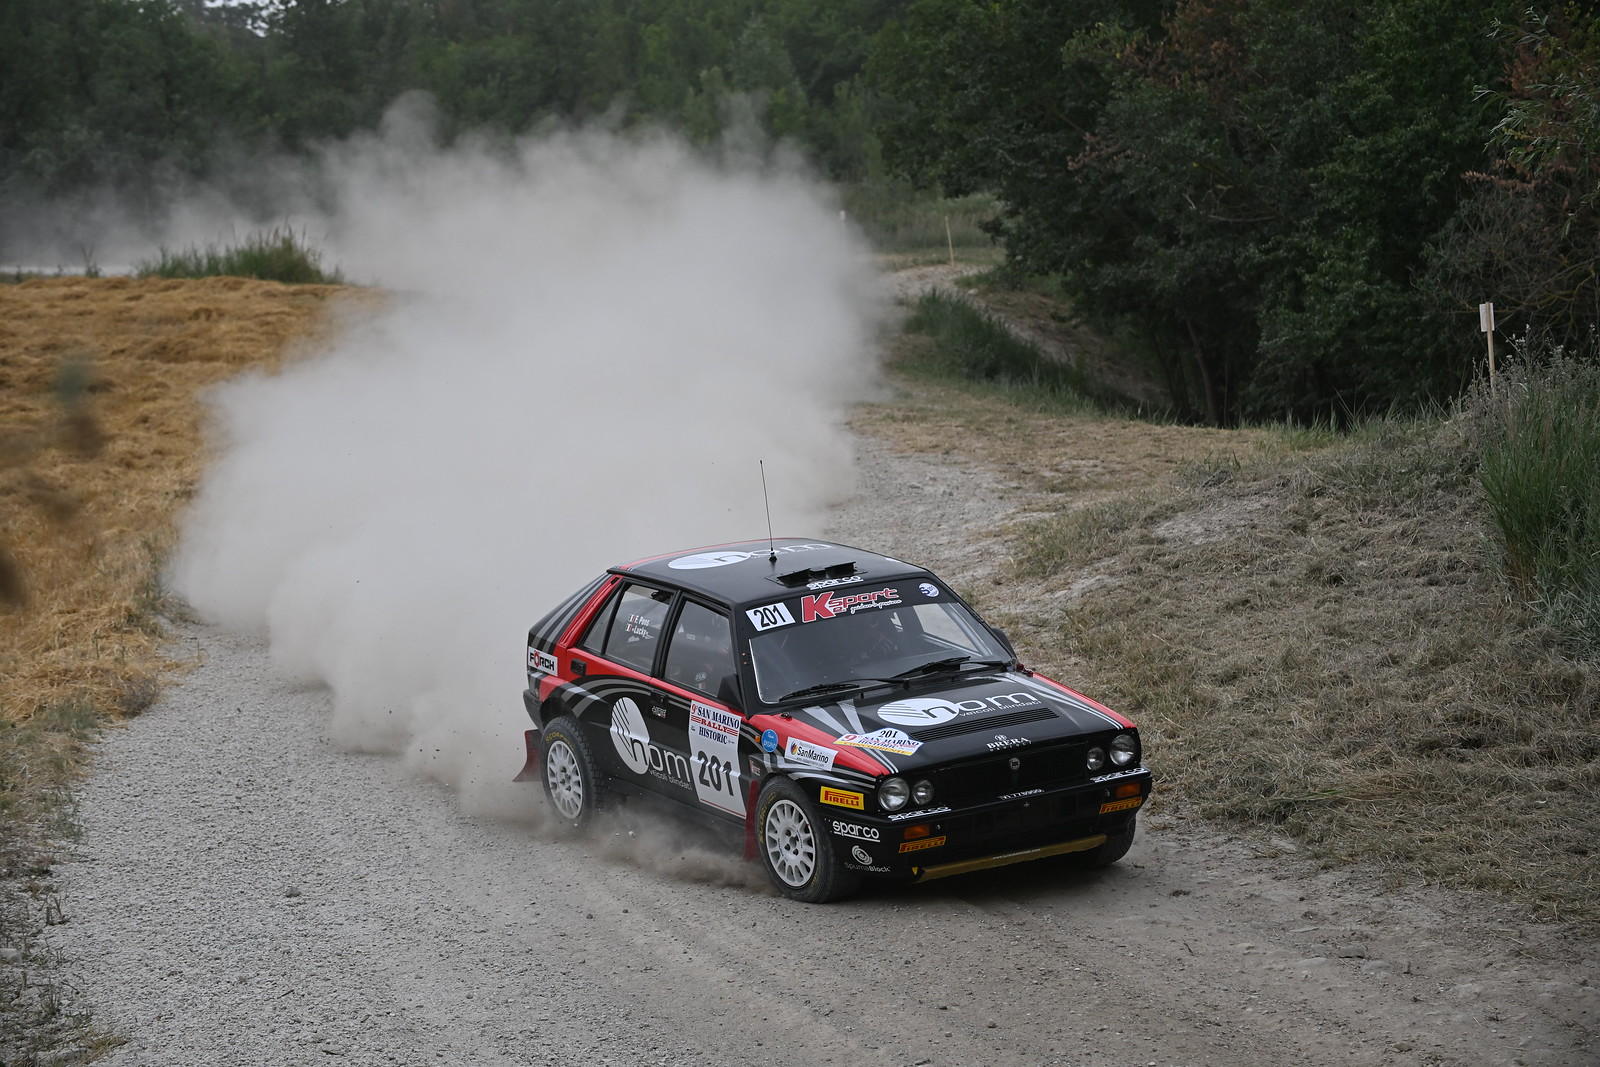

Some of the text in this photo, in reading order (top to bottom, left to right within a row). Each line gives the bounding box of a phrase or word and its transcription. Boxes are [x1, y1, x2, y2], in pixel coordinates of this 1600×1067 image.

[806, 575, 863, 590] sparco
[753, 604, 786, 629] 201
[922, 692, 1038, 719] nom
[697, 706, 711, 719] SAN
[711, 711, 740, 730] MARINO
[701, 718, 729, 733] RALLY
[699, 726, 728, 745] HISTORIC
[878, 730, 898, 739] 201
[986, 737, 1030, 748] BRERA
[797, 746, 829, 764] SanMarino
[697, 751, 735, 797] 201
[824, 790, 860, 807] PIRELLI
[1100, 797, 1142, 813] PIRELLI
[888, 806, 949, 821] sparco
[832, 820, 880, 840] sparco
[900, 837, 945, 852] PIRELLI
